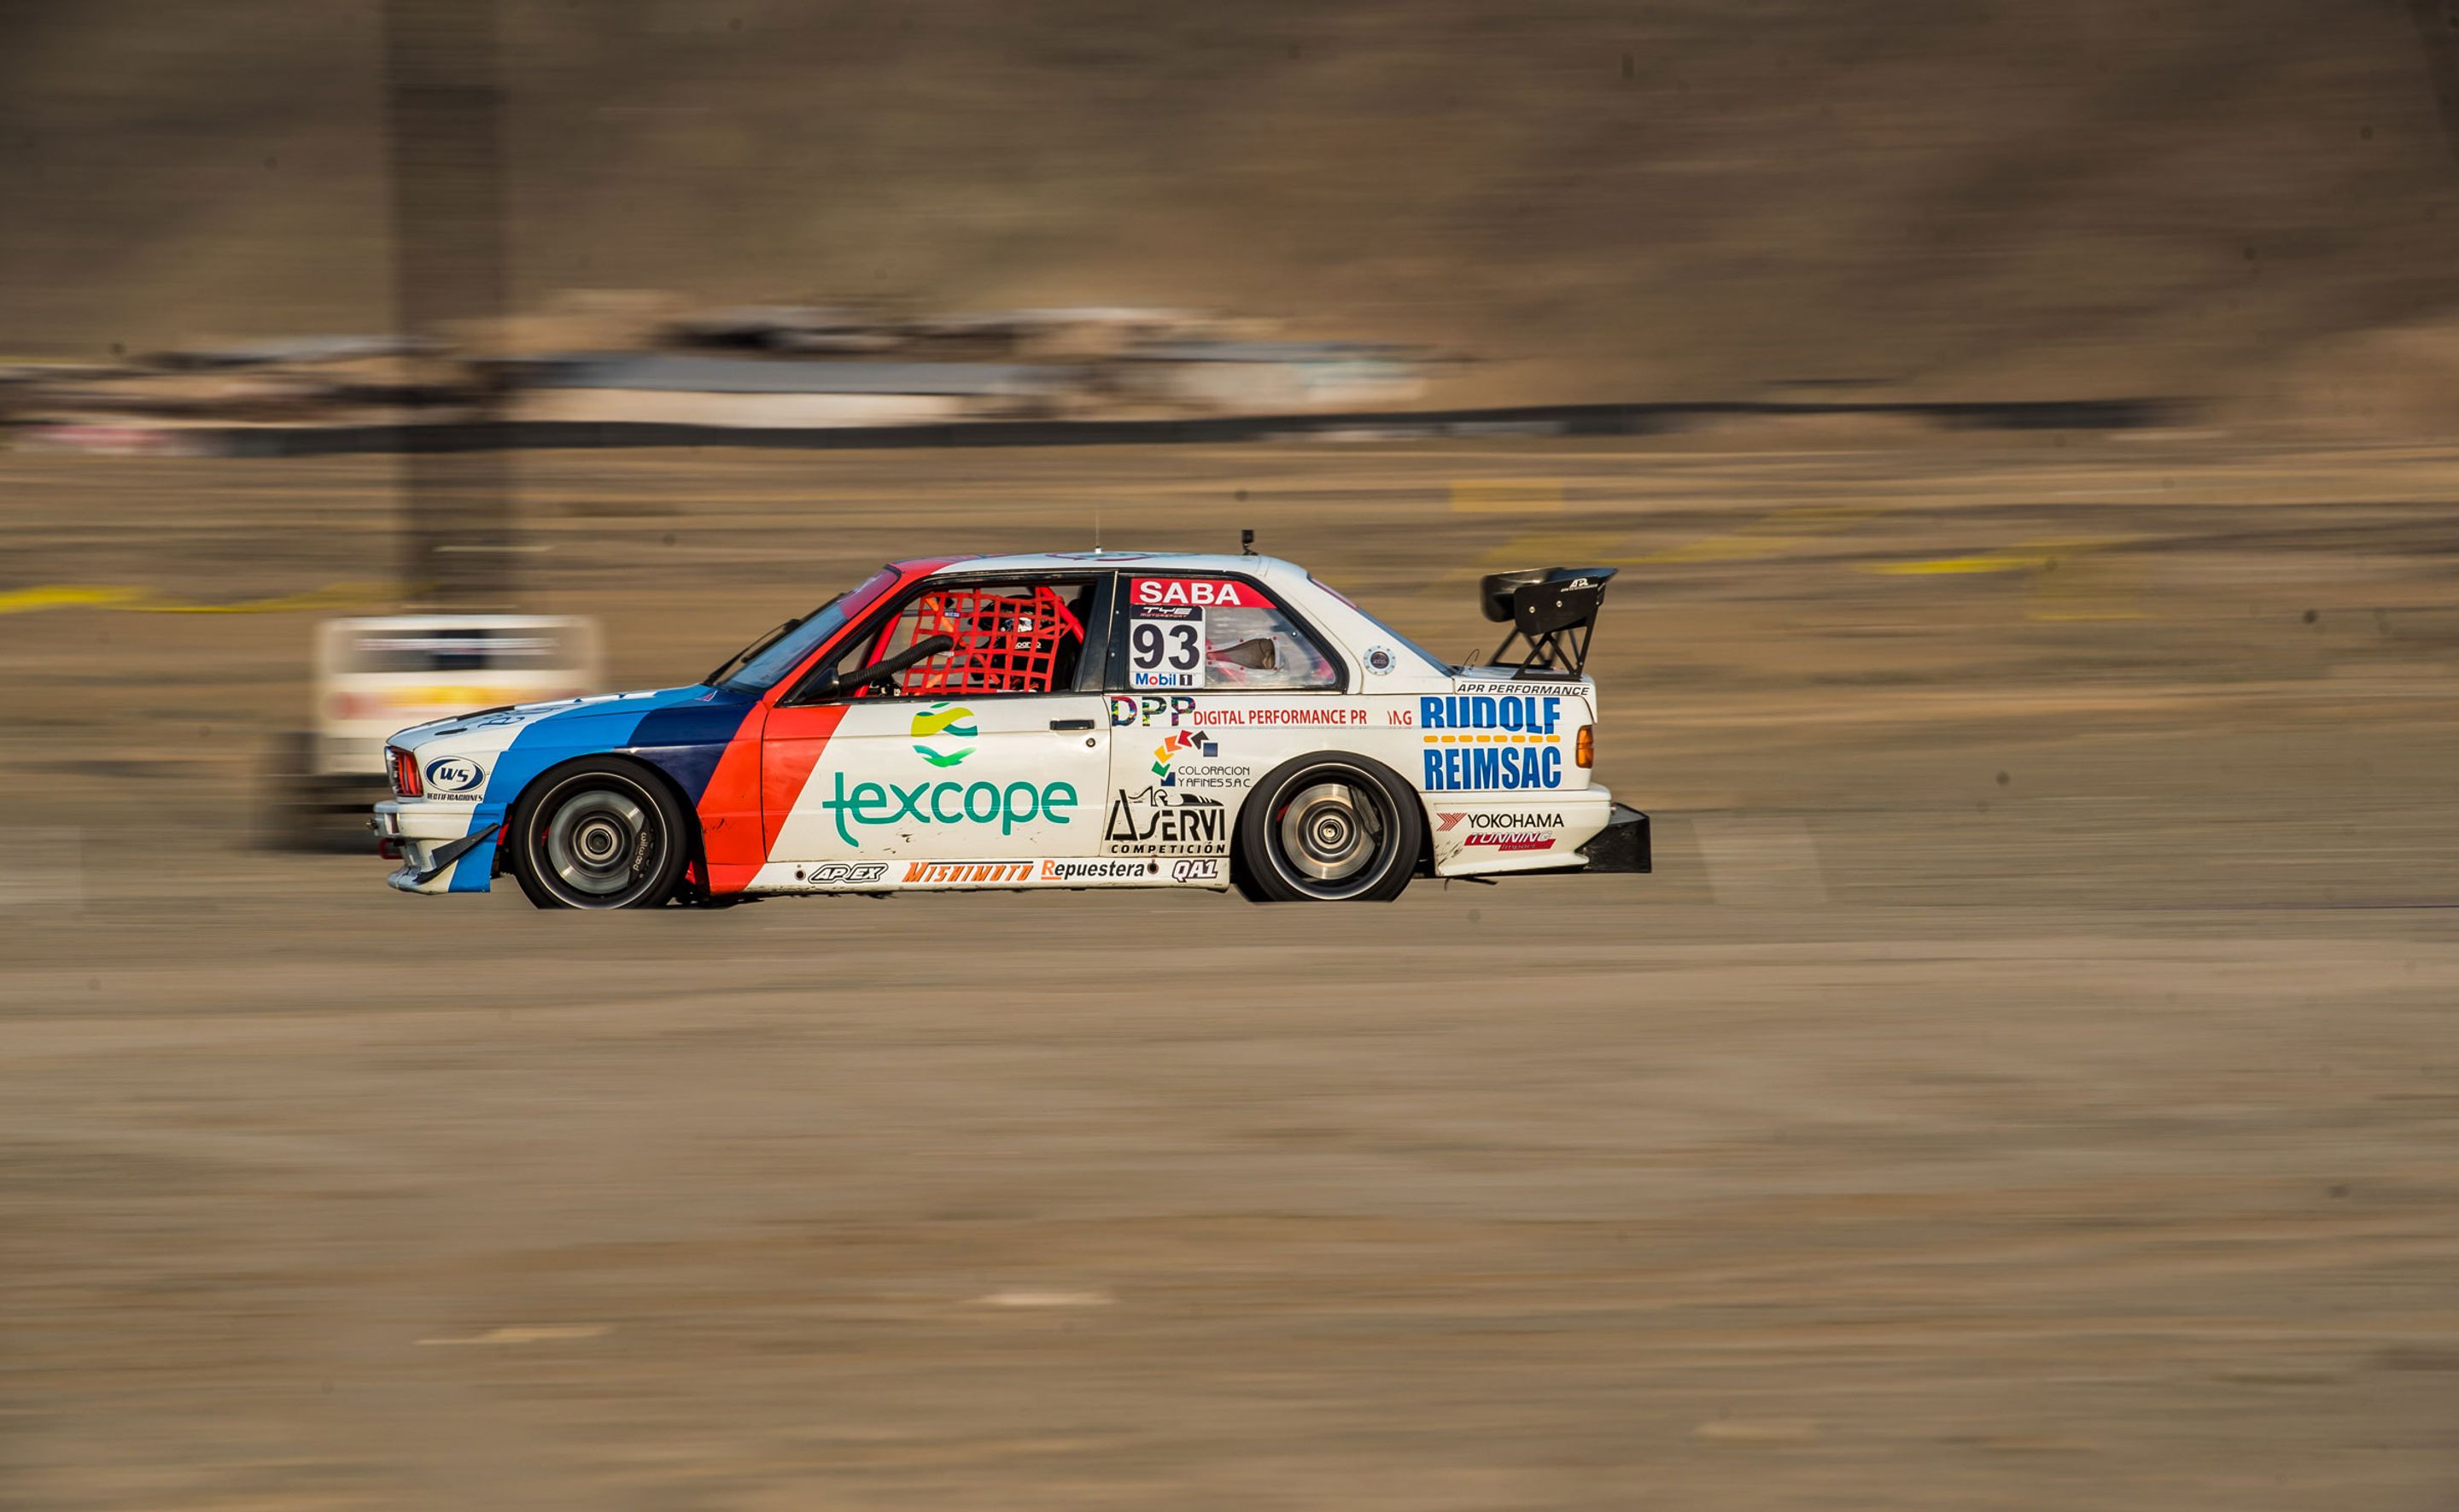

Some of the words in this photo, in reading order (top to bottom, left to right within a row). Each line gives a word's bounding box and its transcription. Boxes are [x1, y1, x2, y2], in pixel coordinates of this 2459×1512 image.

[1139, 581, 1241, 605] SABA
[1133, 623, 1200, 670] 93
[1136, 673, 1177, 686] Mobil
[1180, 674, 1193, 686] 1
[1457, 683, 1485, 693] APR
[1488, 684, 1590, 696] PERFORMANCE
[1111, 696, 1196, 727] DPP
[1194, 710, 1245, 726] DIGITAL
[1248, 709, 1346, 725] PERFORMANCE
[1421, 696, 1561, 734] RUDOLF
[440, 768, 470, 782] WS
[1178, 766, 1250, 776] COLORACION
[1423, 746, 1562, 791] REIMSAC
[822, 772, 1078, 848] texcope
[1468, 814, 1564, 828] YOKOHAMA
[1112, 842, 1225, 854] COMPETICIÓN
[1470, 832, 1552, 844] TUNNING
[633, 832, 648, 871] wilwood
[1041, 859, 1145, 880] Repuestera
[1171, 859, 1218, 883] QA1
